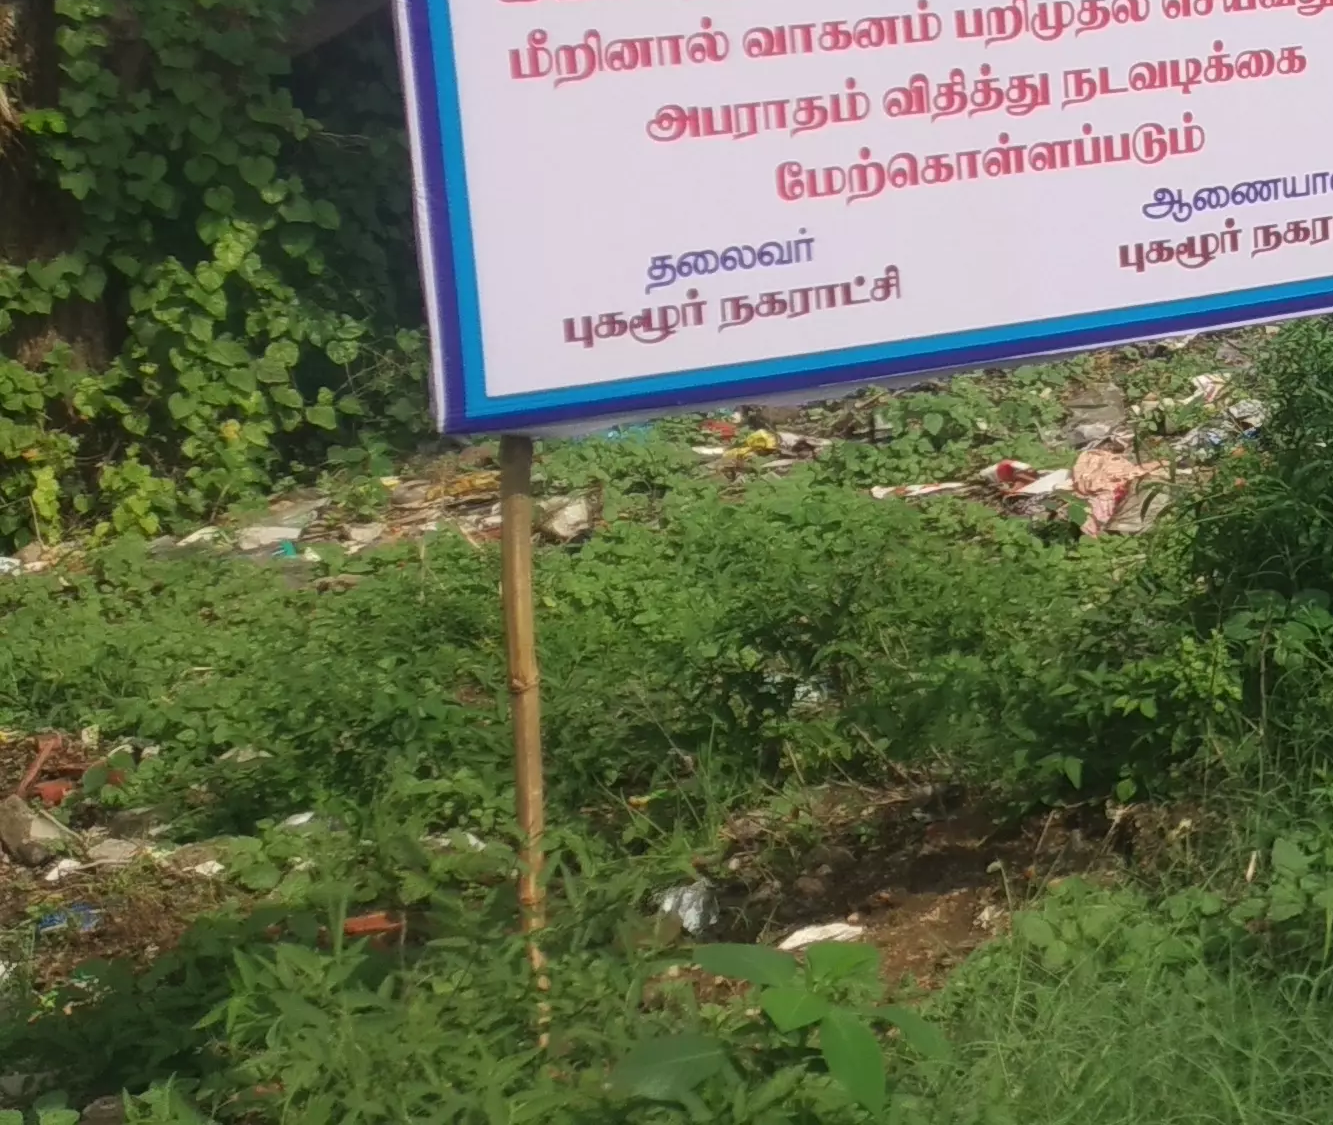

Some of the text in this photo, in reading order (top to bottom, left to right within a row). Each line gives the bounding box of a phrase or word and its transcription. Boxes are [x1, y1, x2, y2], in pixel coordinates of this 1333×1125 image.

[508, 16, 730, 89] மீறினால்
[645, 39, 1307, 144] அபராதம் விதித்து நடவடிக்கை
[774, 111, 1206, 206] மேற்கொள்ளப்படும்
[644, 227, 816, 295] தலைவர்
[1118, 217, 1243, 273] புகழூர்
[562, 264, 902, 349] புகழூர் நகராட்சி
